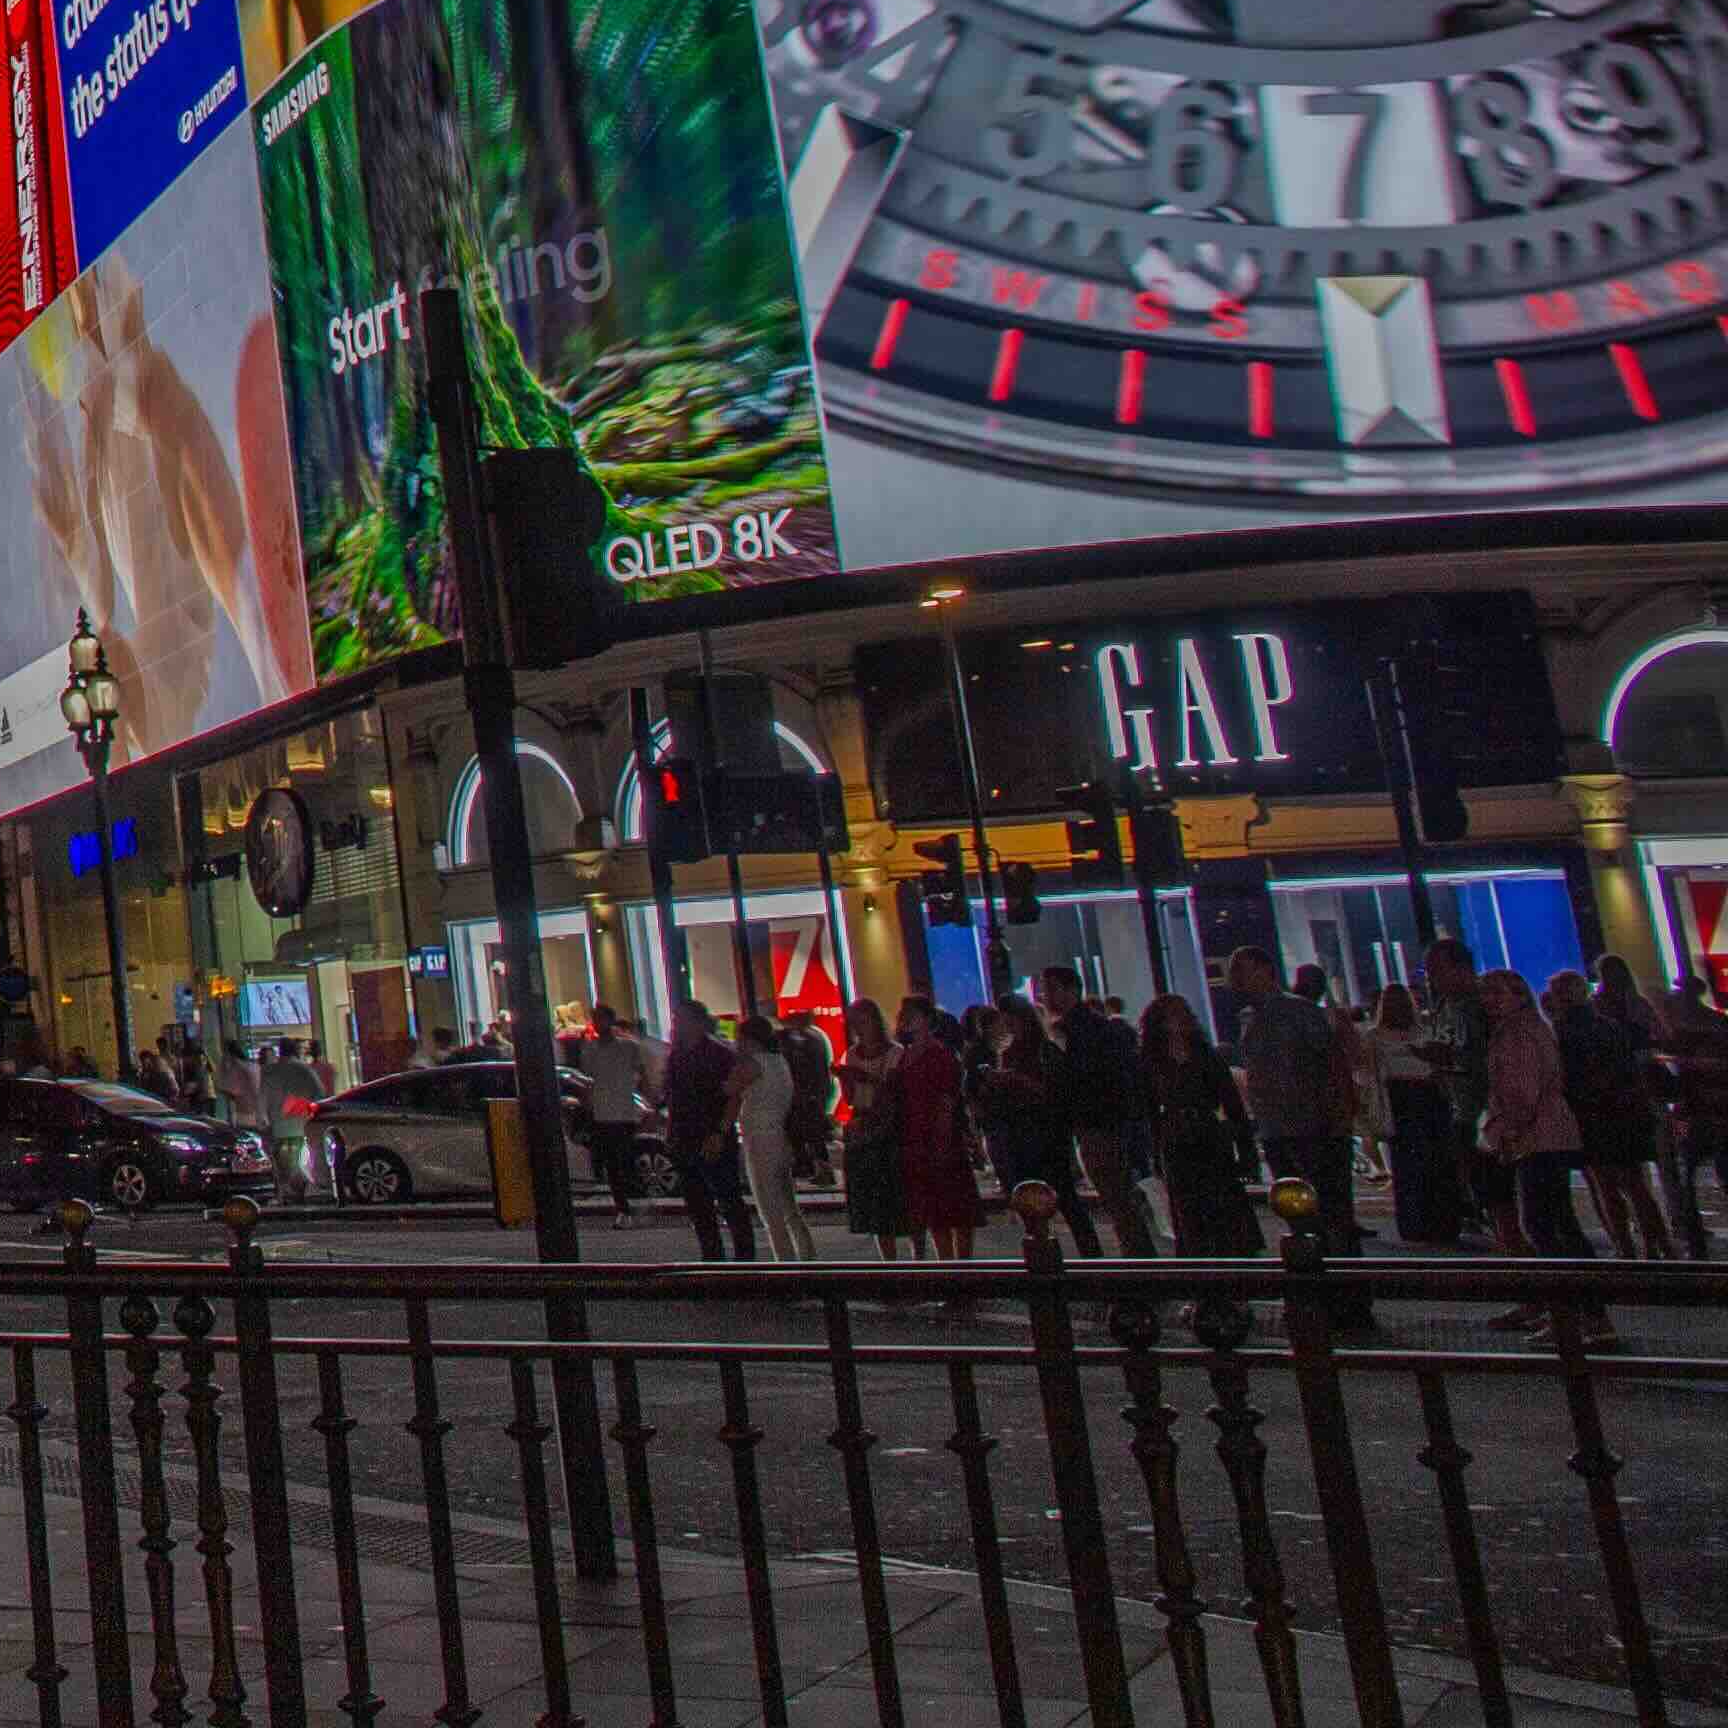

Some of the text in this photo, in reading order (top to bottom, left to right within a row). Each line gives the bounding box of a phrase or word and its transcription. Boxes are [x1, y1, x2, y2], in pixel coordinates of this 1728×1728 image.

[70, 71, 105, 140] the
[261, 62, 332, 147] SAMSUNG
[1301, 90, 1390, 220] 7
[1449, 68, 1558, 210] 8
[10, 55, 40, 312] ENERGY
[328, 280, 411, 374] Start
[921, 249, 1250, 340] SWISS
[603, 508, 802, 583] QLED 8K
[1093, 631, 1295, 772] GAP
